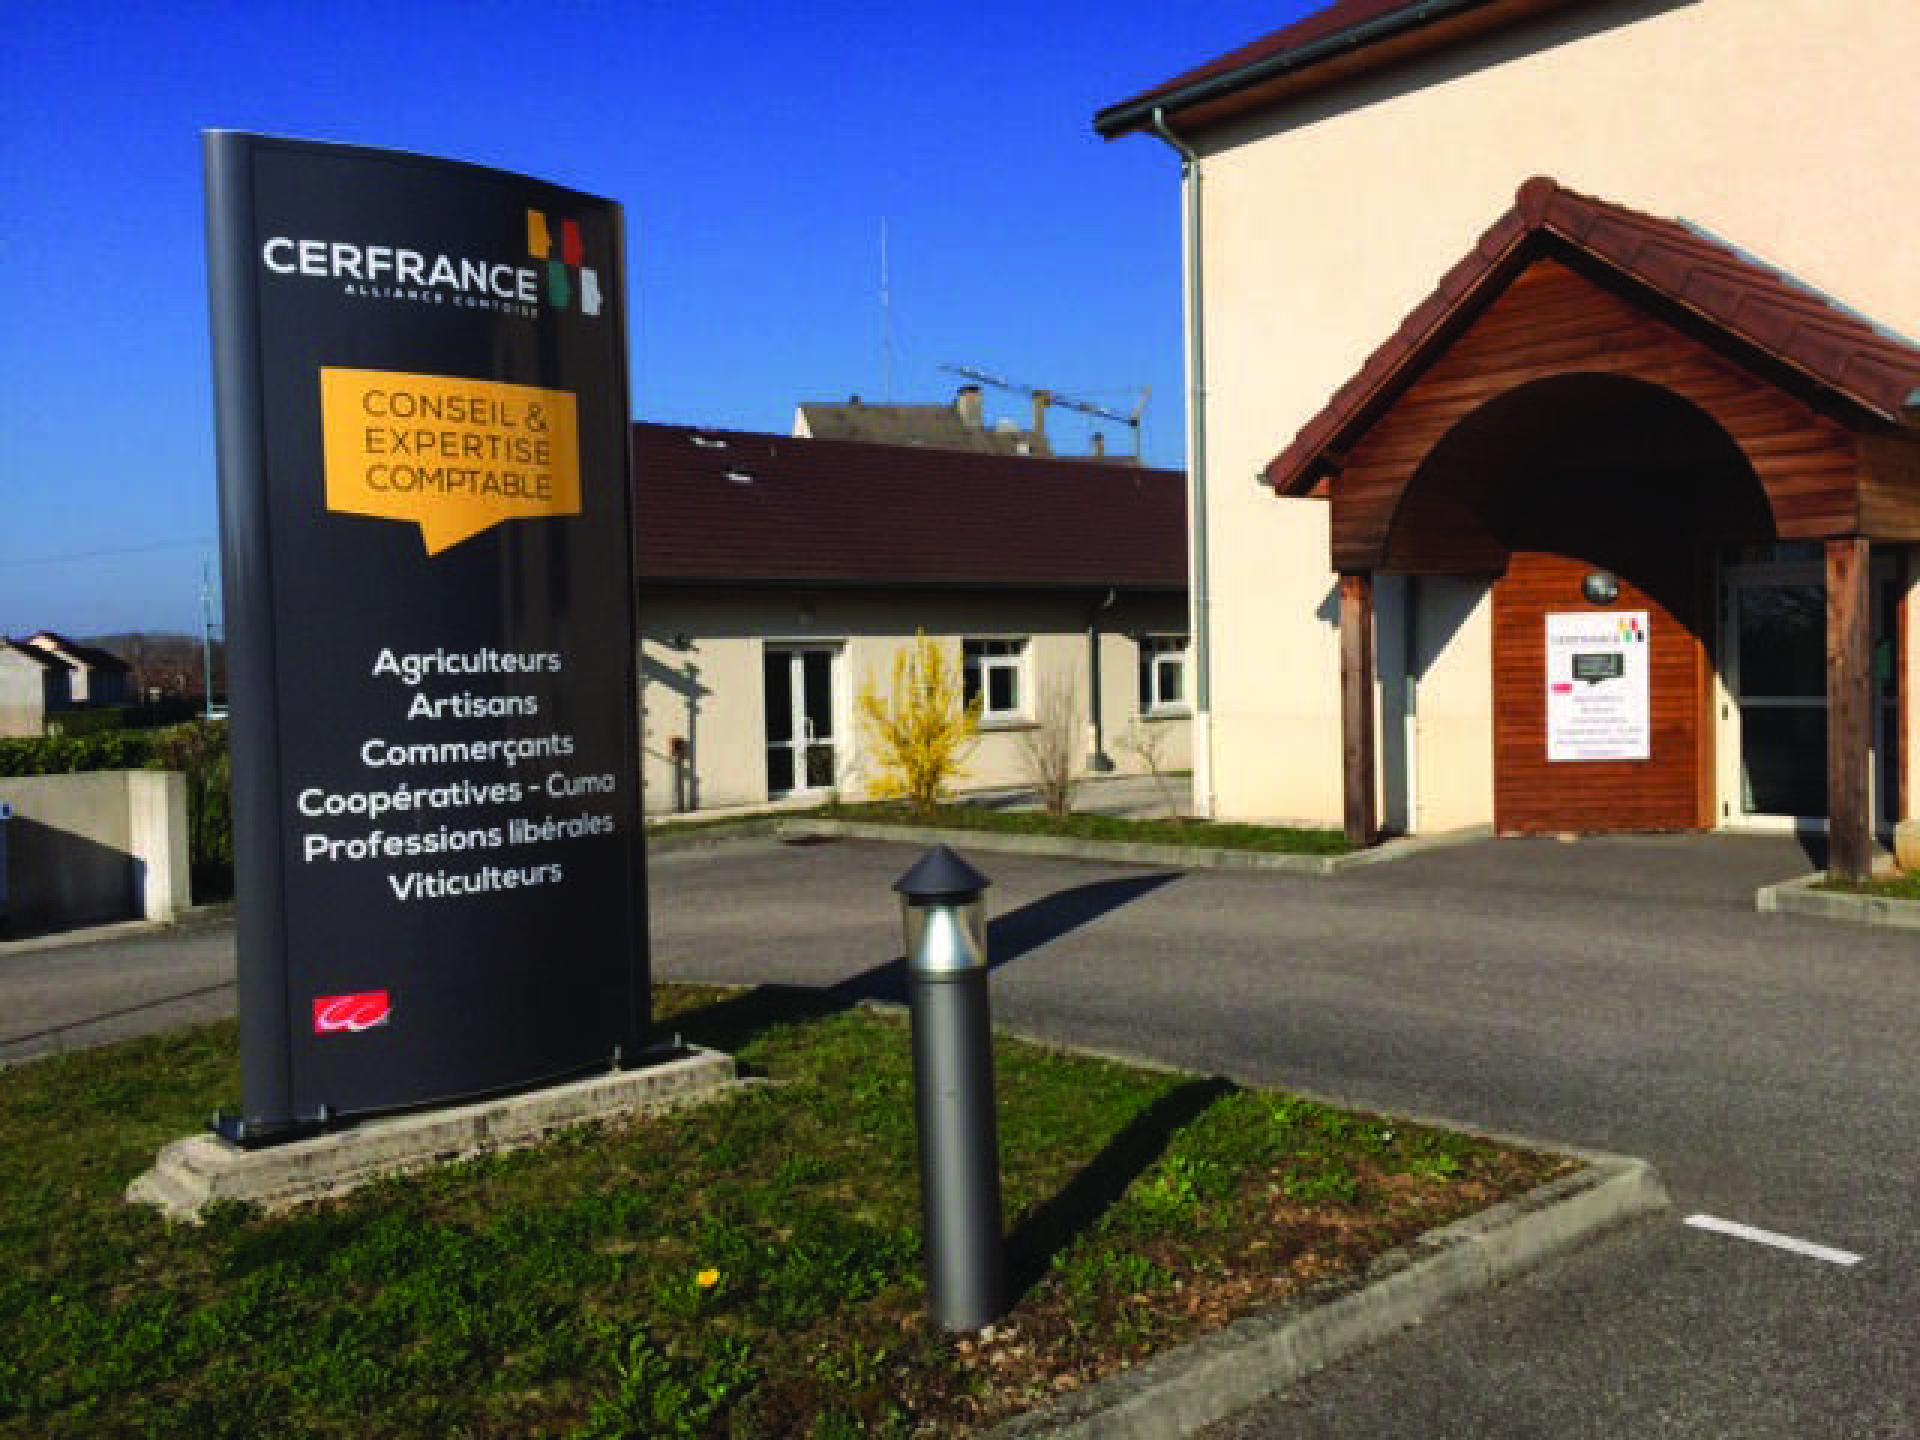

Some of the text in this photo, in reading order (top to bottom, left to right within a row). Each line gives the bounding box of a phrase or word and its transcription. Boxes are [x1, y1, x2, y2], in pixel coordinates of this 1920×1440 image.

[263, 236, 538, 303] CERFRANCE
[362, 389, 550, 433] CONSEIL &
[365, 428, 552, 466] EXPERTISE
[365, 464, 552, 499] COMPTABLE
[372, 647, 562, 685] Agriculteurs
[407, 690, 538, 720] Artisans
[360, 732, 574, 767] Commerçants
[297, 779, 522, 819] Coopératives
[546, 770, 616, 798] Cuma
[303, 811, 614, 862] Professions libérales
[387, 863, 562, 901] Viticulteurs
